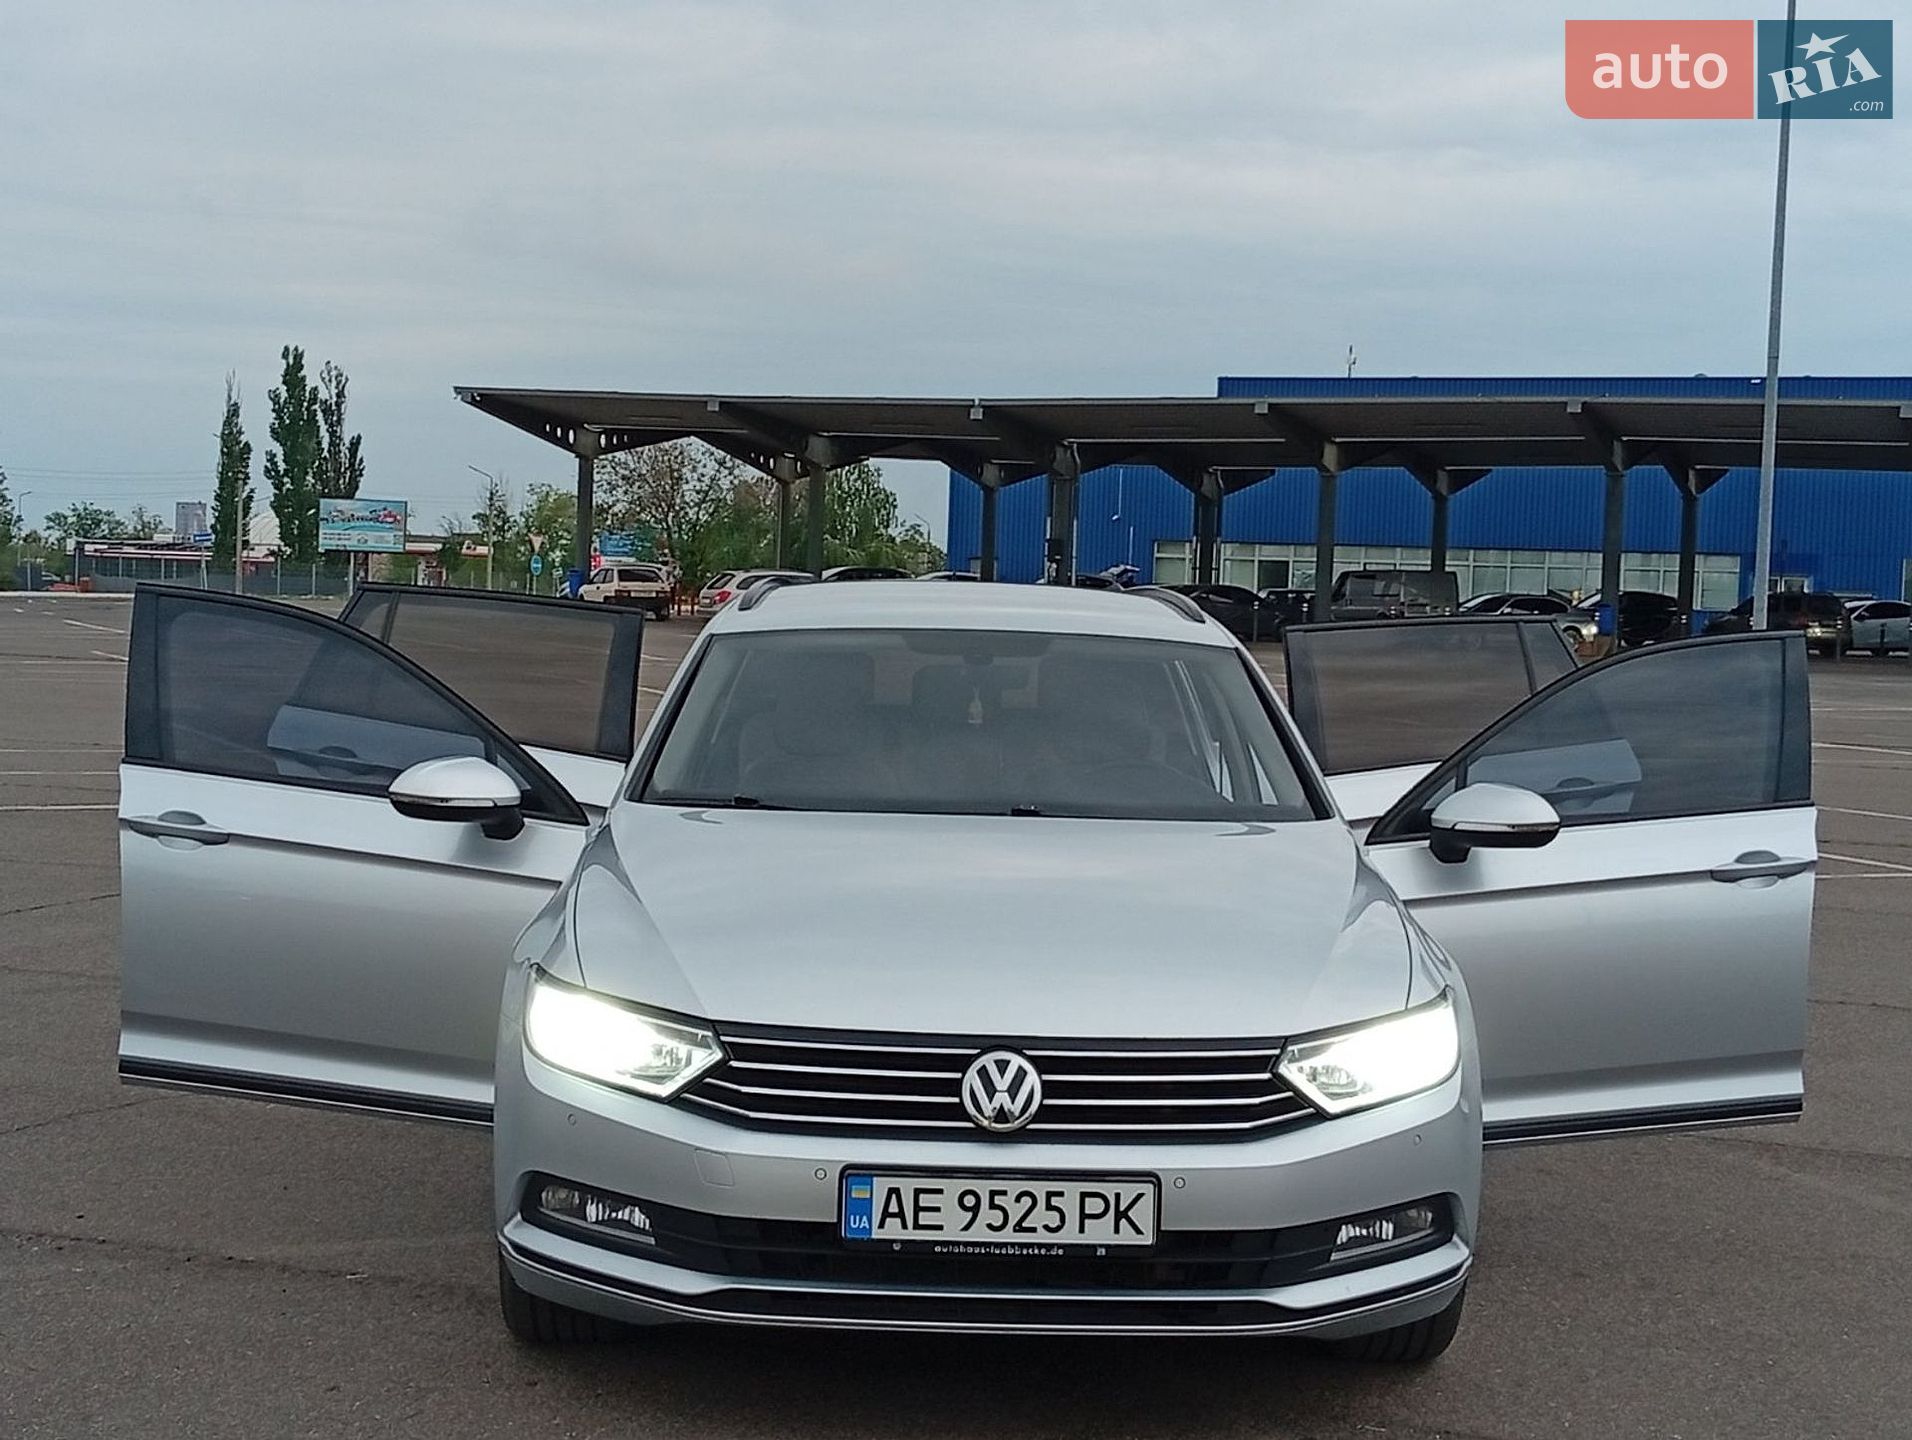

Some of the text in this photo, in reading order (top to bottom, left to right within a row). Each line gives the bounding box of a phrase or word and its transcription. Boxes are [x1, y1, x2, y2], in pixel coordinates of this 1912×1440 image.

[850, 1214, 870, 1229] UA
[877, 1186, 1147, 1236] AE 9525 PK
